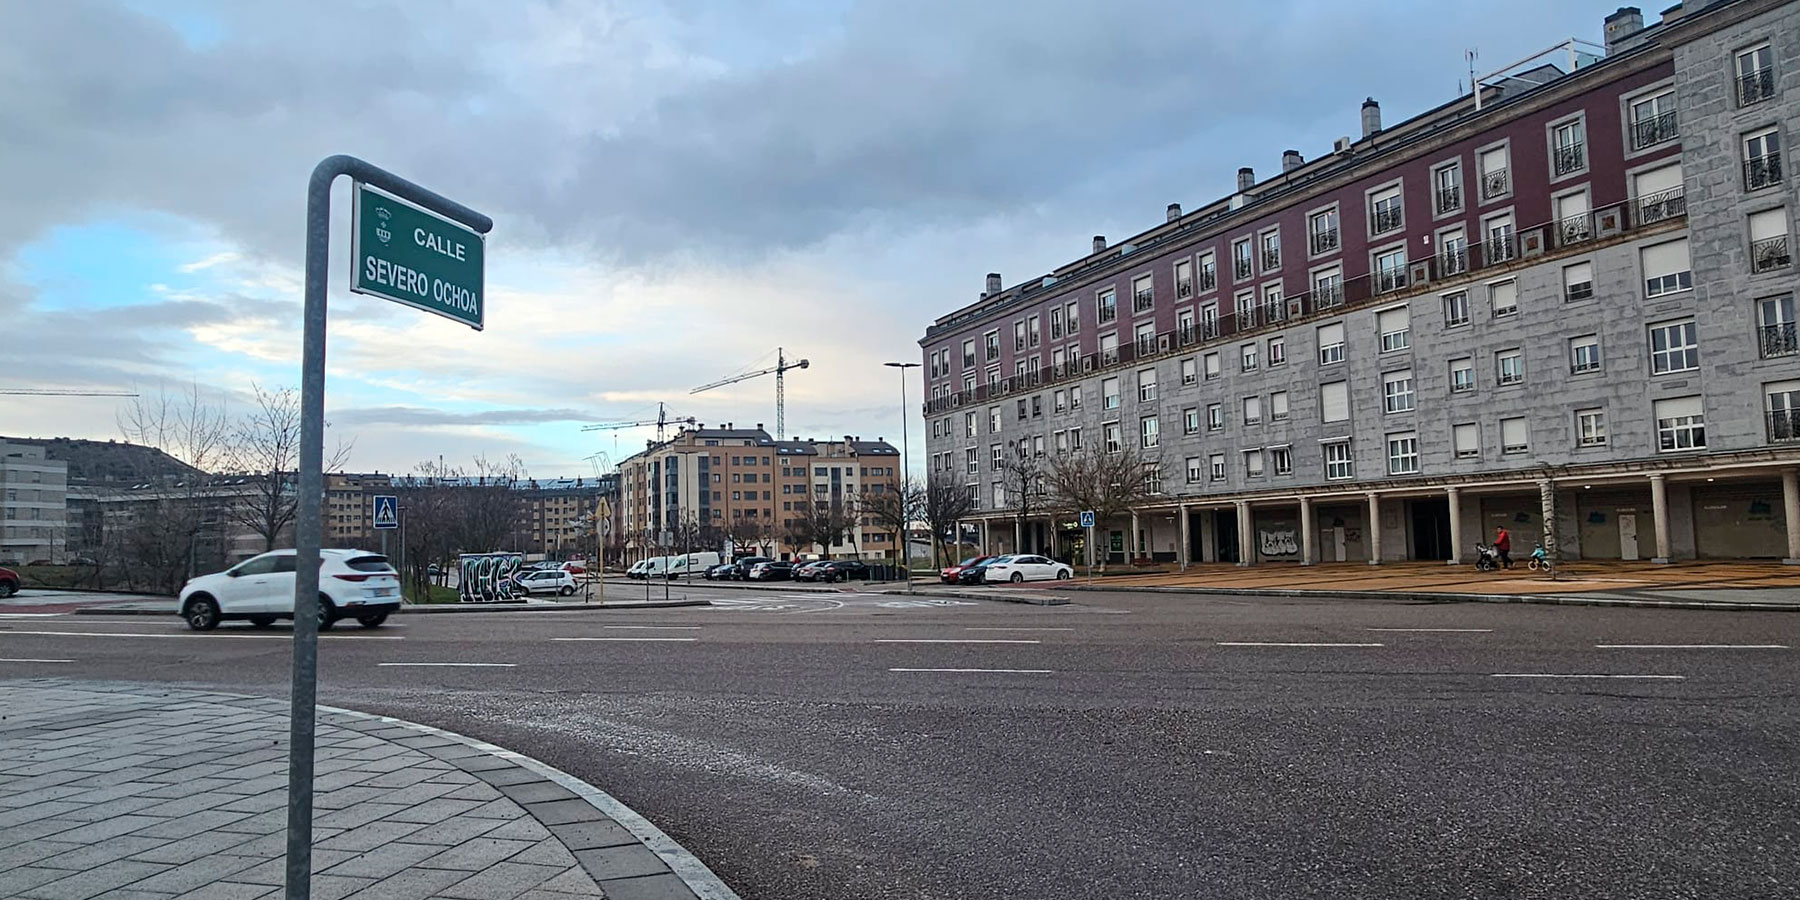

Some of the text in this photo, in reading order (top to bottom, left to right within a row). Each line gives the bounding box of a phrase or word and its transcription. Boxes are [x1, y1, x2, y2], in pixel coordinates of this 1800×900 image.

[414, 228, 466, 262] CALLE
[366, 256, 478, 315] SEVERO OCHOA
